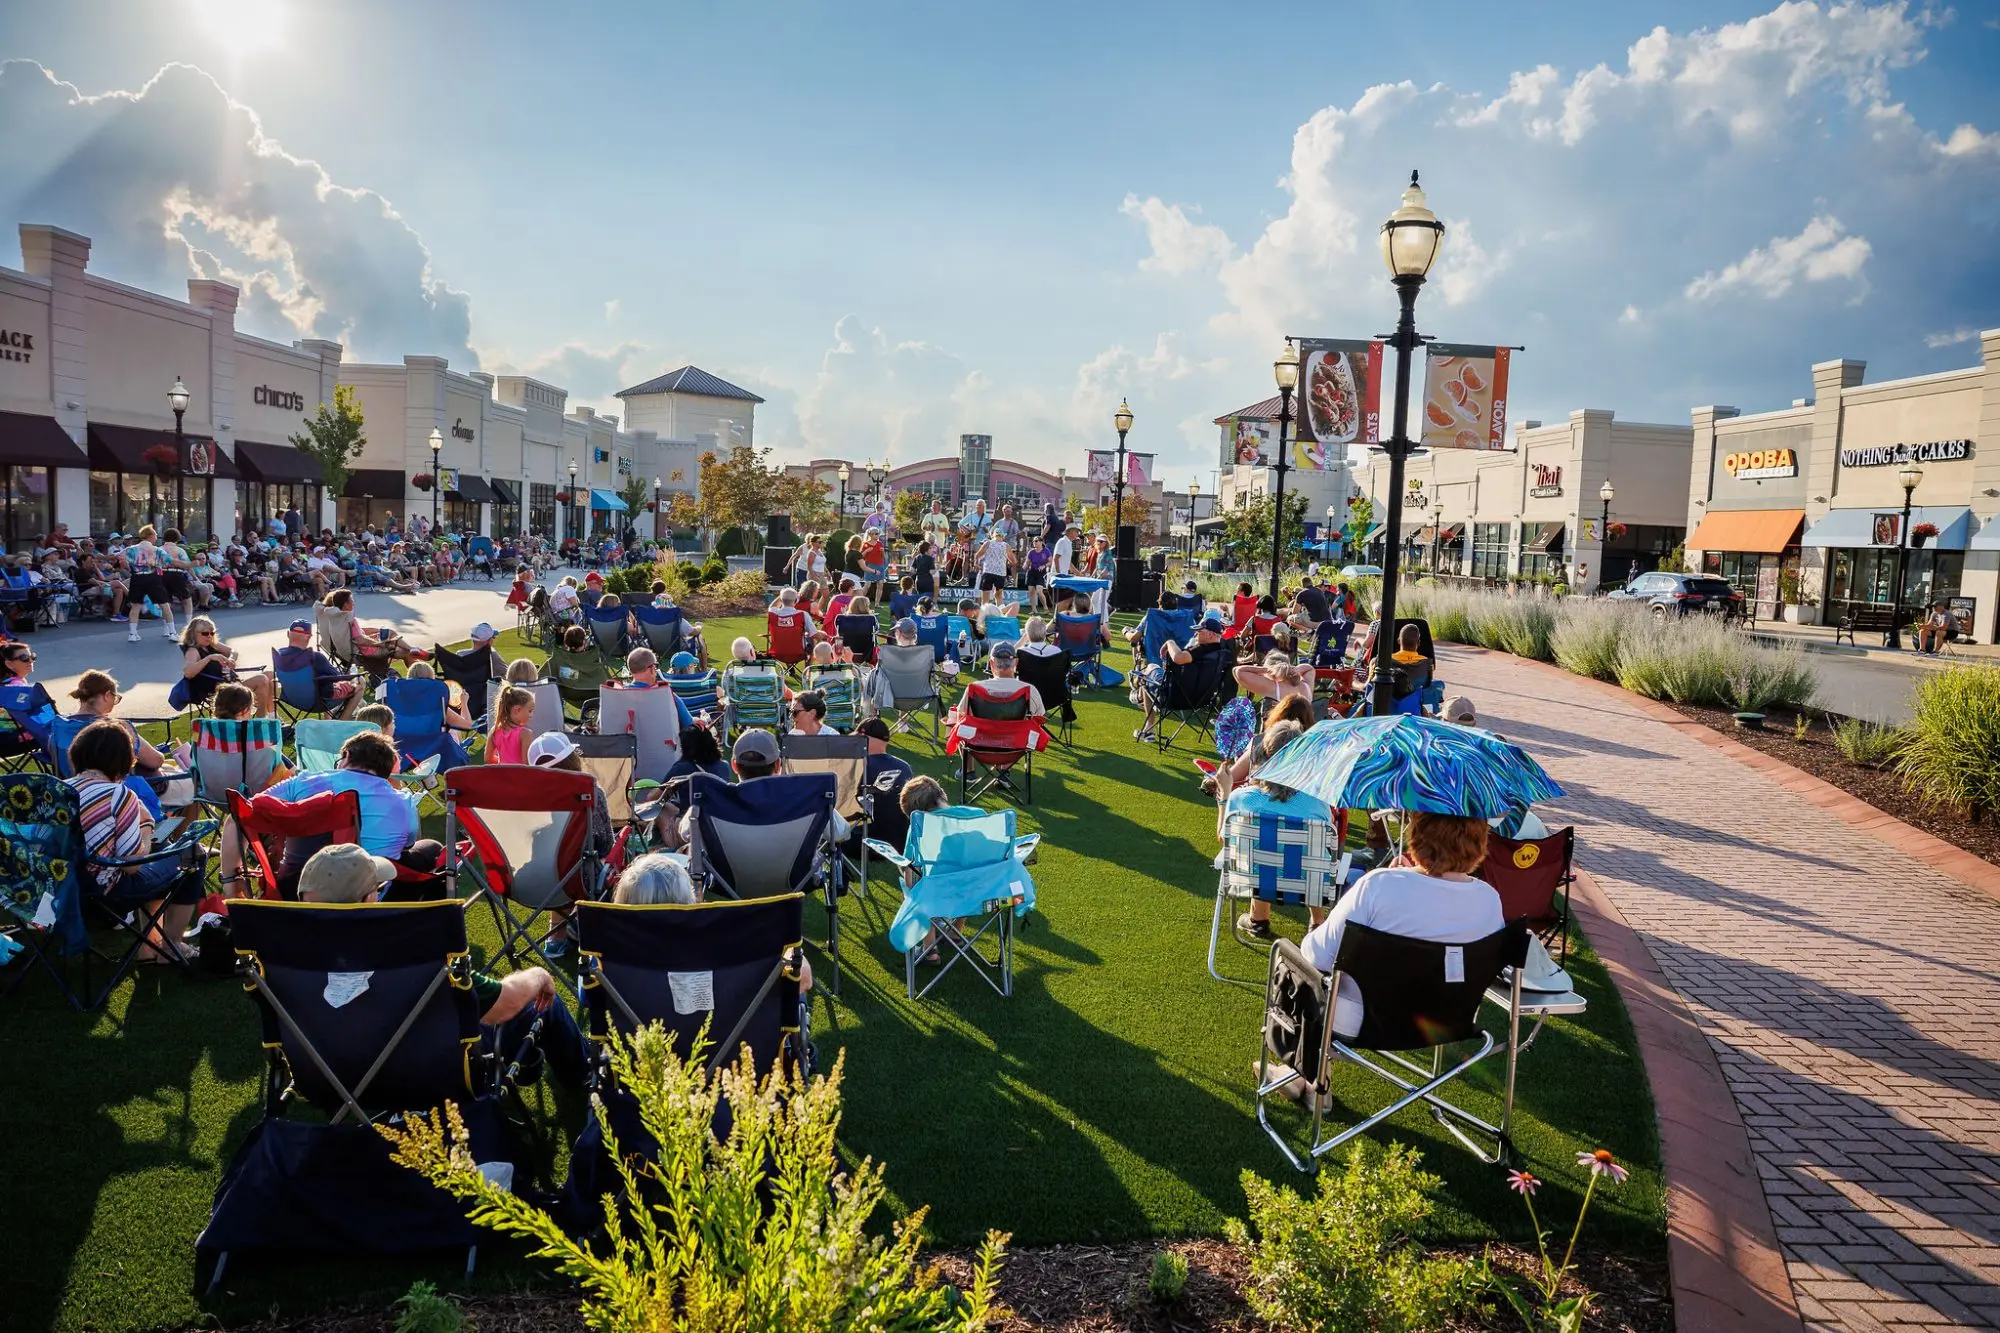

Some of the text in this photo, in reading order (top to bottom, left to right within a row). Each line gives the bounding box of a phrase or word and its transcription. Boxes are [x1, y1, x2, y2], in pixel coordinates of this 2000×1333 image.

[1366, 412, 1379, 444] EATS
[1491, 400, 1505, 450] FLAVOR
[1724, 448, 1792, 476] QDOBA
[1840, 446, 1892, 466] NOTHING
[1918, 440, 1966, 460] CAKES
